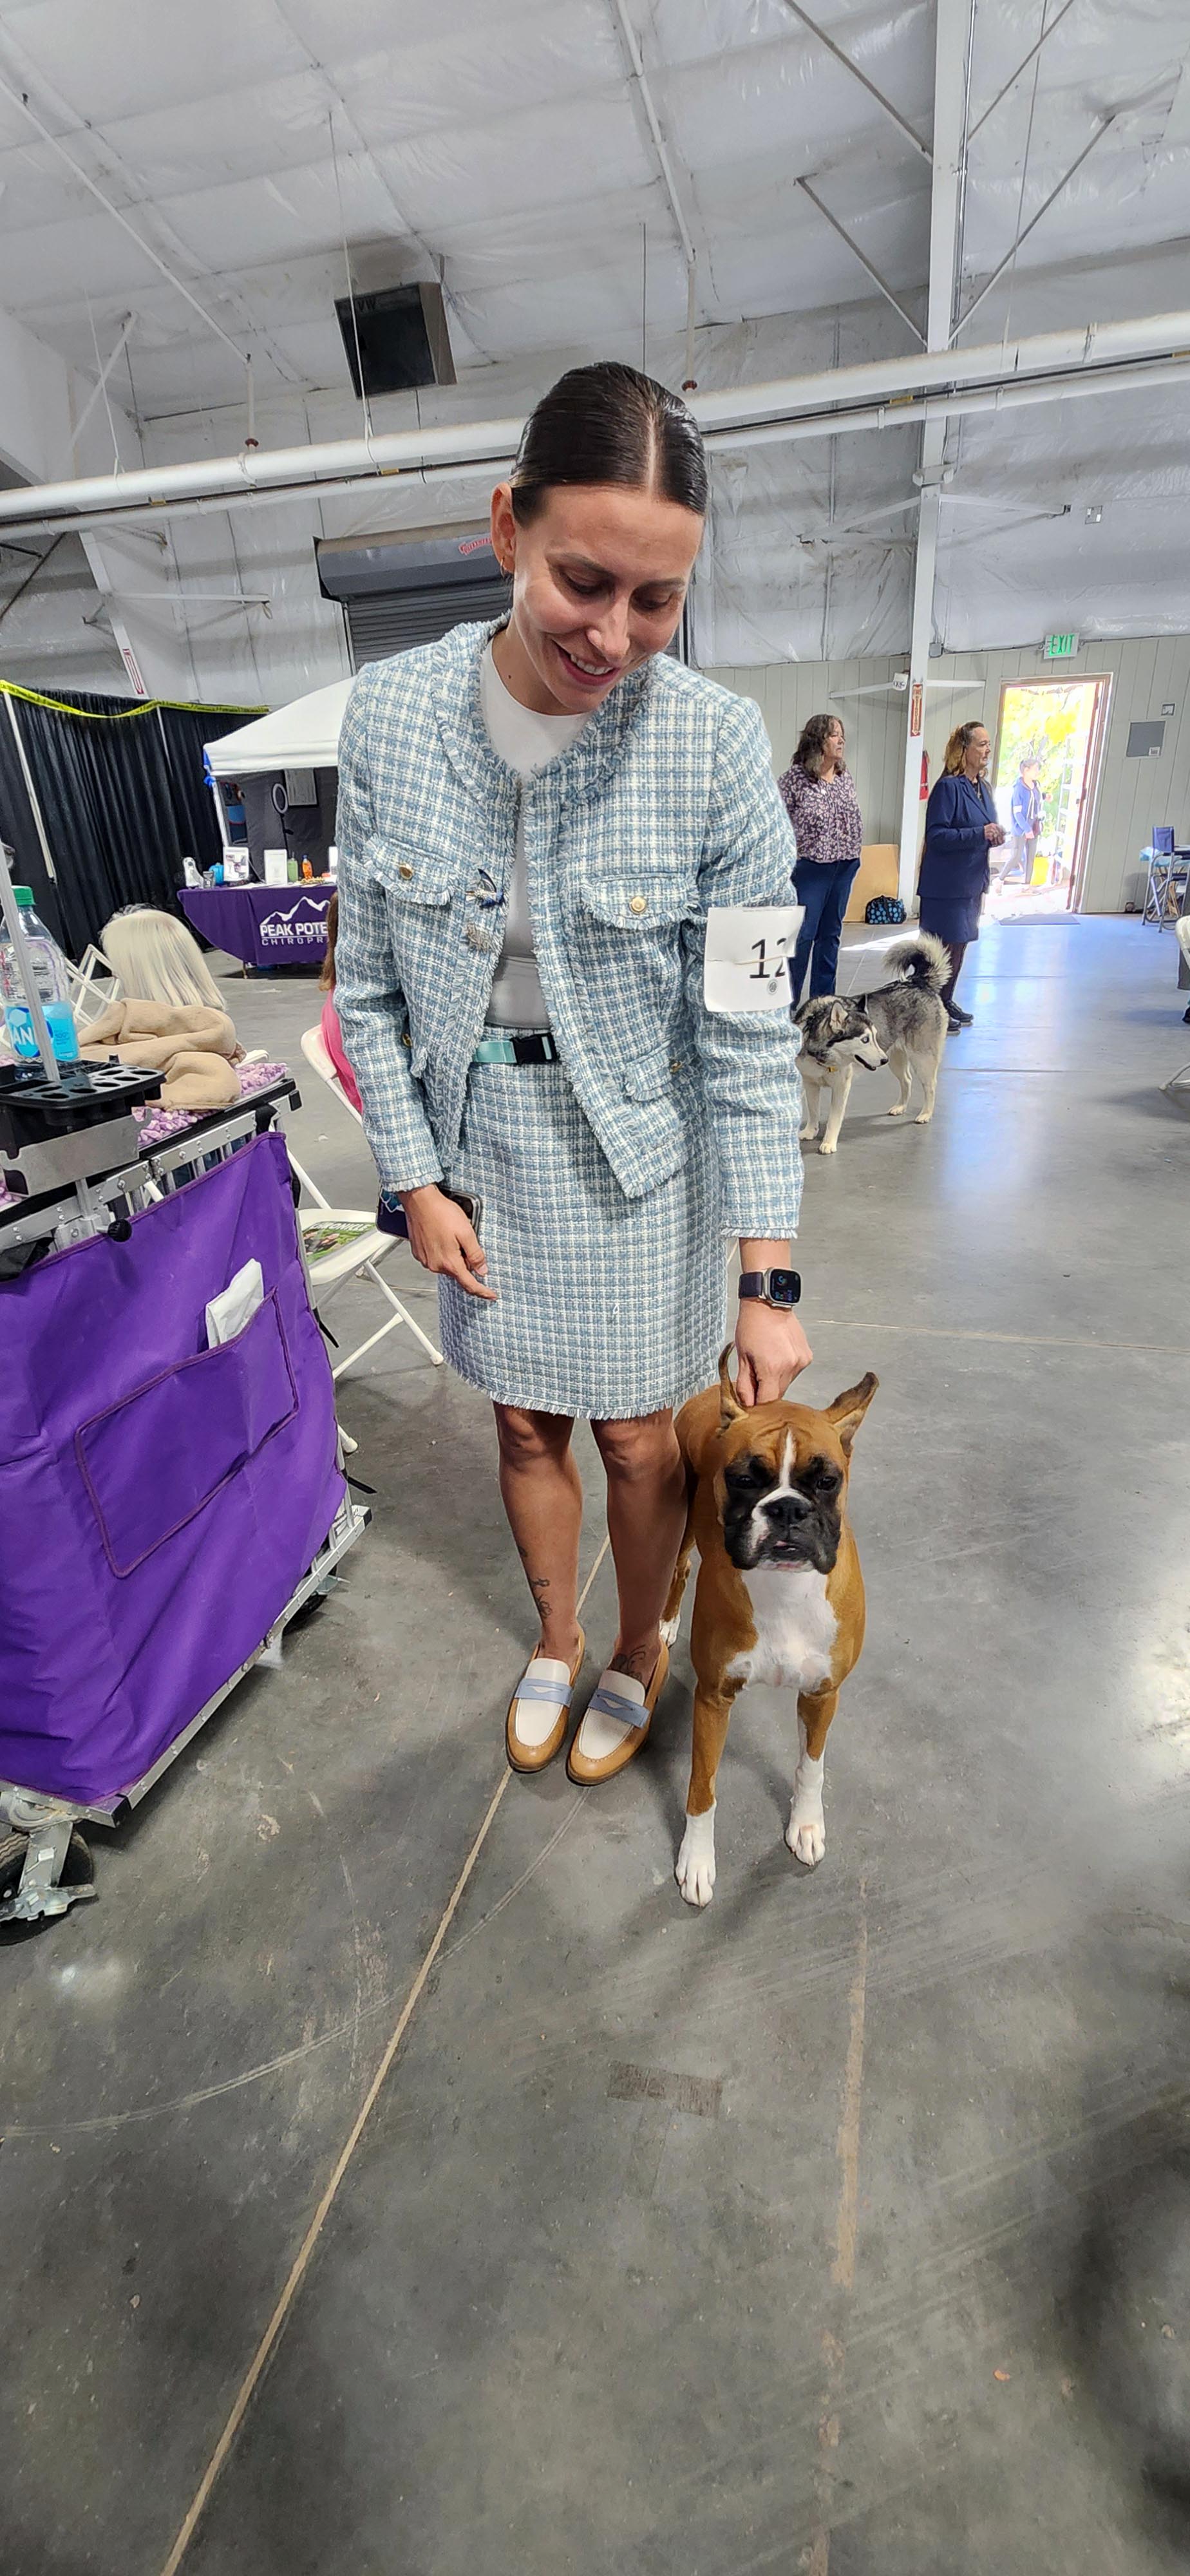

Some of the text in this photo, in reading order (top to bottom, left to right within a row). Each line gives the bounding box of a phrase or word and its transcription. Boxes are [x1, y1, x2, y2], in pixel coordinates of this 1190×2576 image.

[1050, 634, 1075, 656] EXIT
[260, 923, 294, 936] PEAK
[261, 937, 329, 946] CHIROPR
